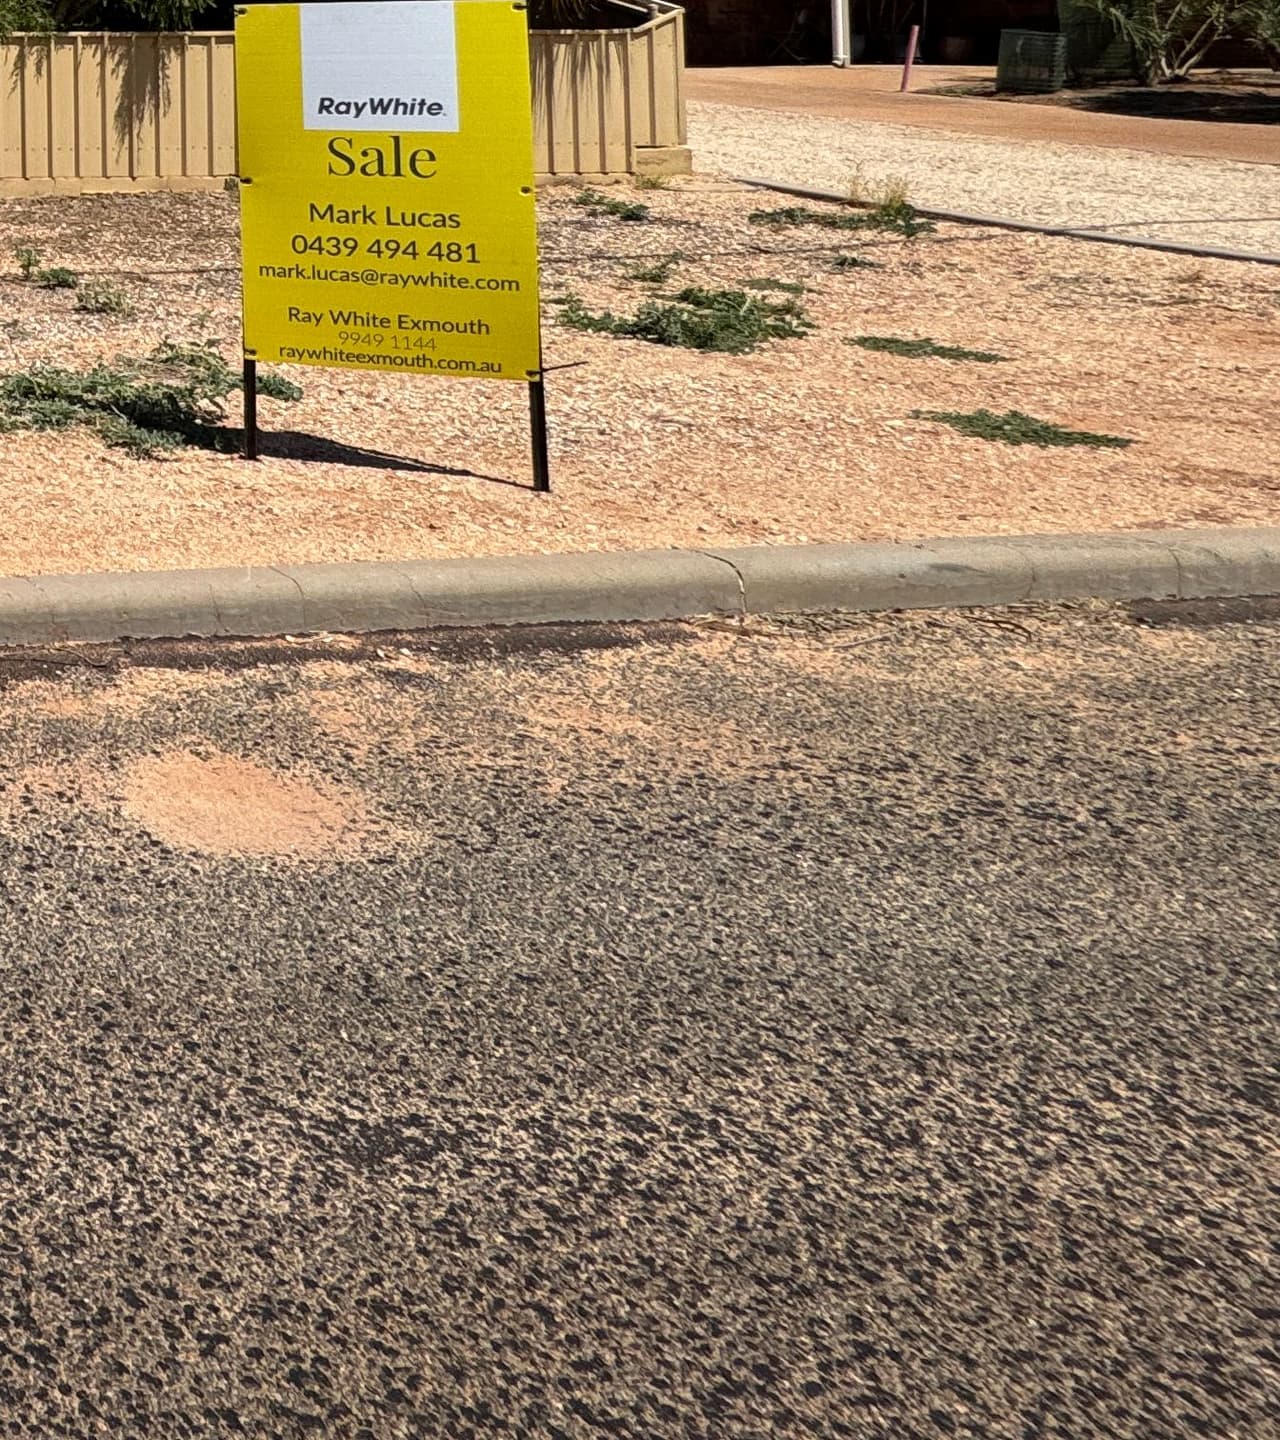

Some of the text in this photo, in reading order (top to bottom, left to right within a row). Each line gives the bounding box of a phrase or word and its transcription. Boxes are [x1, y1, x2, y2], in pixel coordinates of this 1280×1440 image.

[327, 135, 437, 179] Sale
[309, 203, 461, 229] Mark Lucas
[291, 234, 481, 264] 0439 494 481
[259, 263, 520, 292] mark.lucas@raywhite.com
[288, 306, 490, 335] Ray White Exmouth
[339, 331, 437, 351] 9949 1144
[279, 346, 502, 373] raywhiteexmouth.com.au
